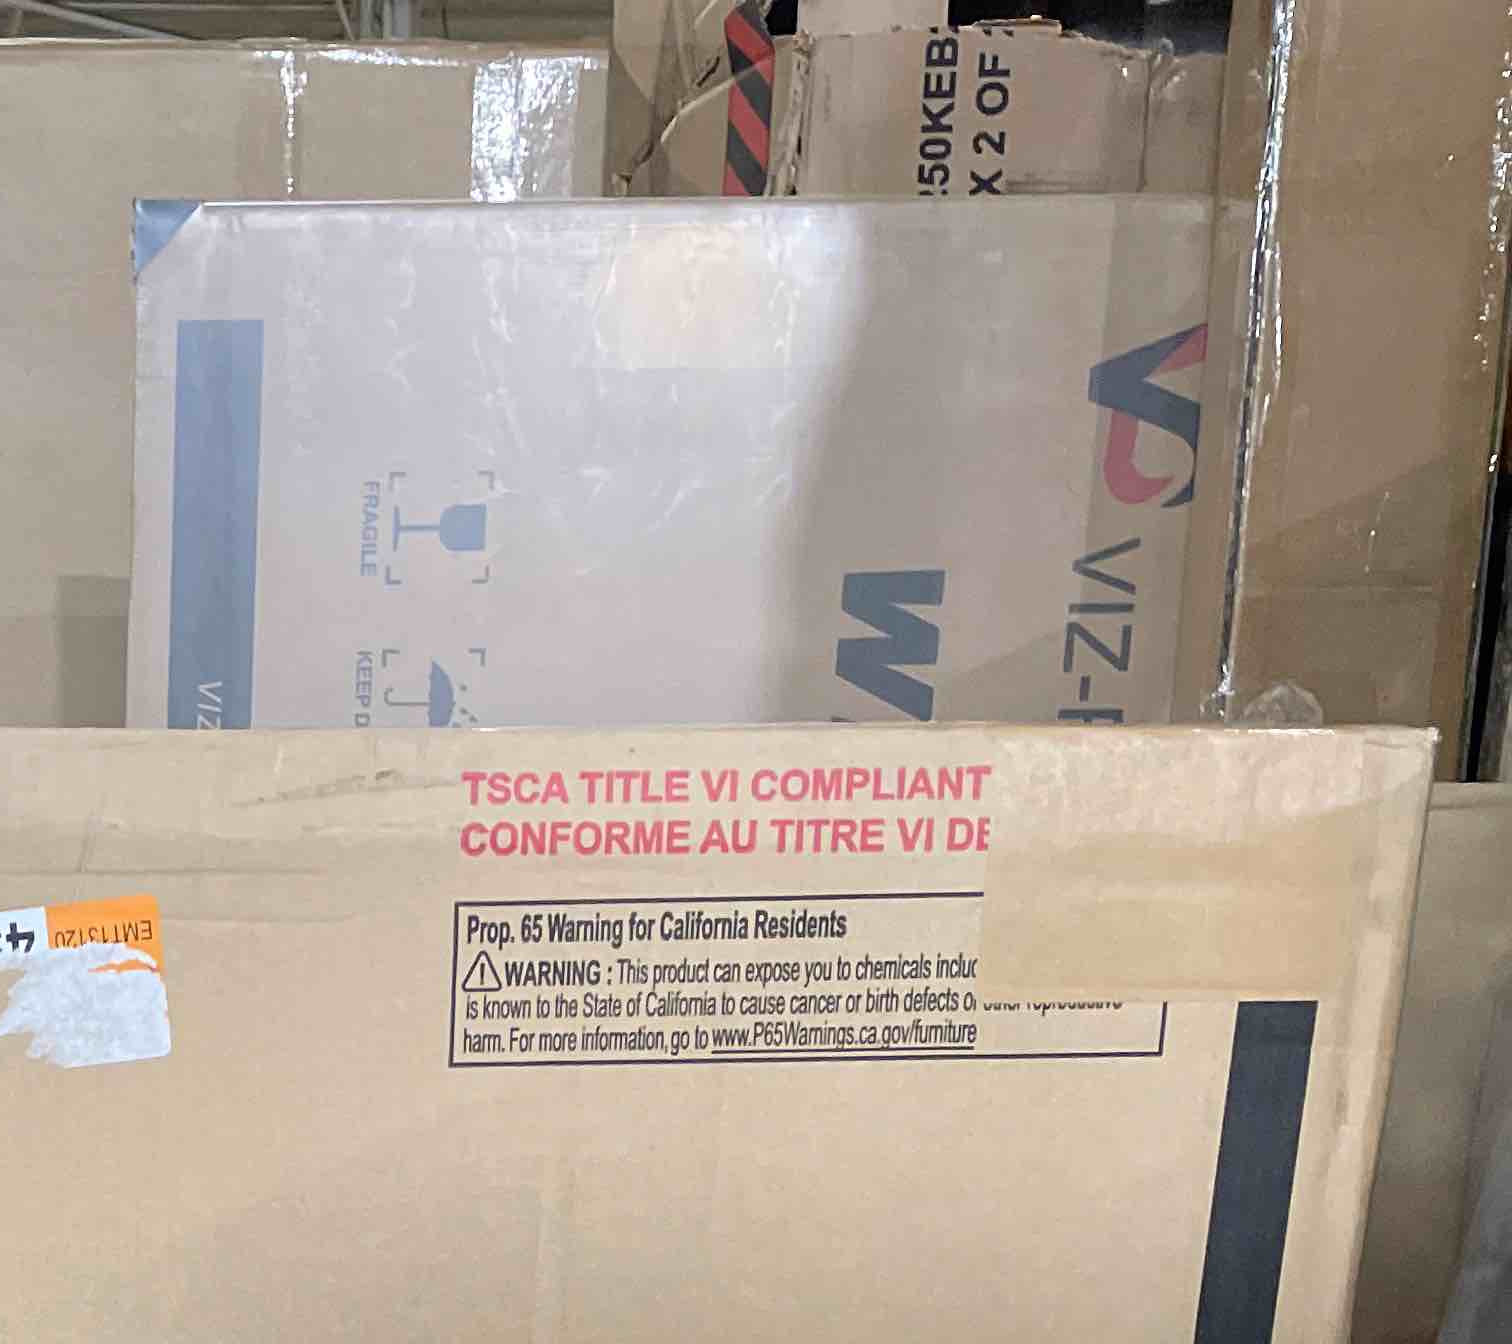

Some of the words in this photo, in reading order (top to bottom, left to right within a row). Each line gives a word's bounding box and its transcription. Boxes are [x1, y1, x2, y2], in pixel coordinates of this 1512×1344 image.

[977, 53, 1011, 117] OF
[918, 25, 959, 196] 50KEB
[360, 481, 381, 577] FRAGILE
[355, 651, 373, 708] KEEP
[460, 771, 569, 806] TSCA
[579, 769, 692, 804] TITLE
[700, 768, 739, 802] VI
[750, 765, 992, 802] COMPLIANT
[459, 820, 696, 857] CONFORME
[698, 819, 758, 855] AU
[769, 818, 884, 854] TITRE
[896, 817, 935, 853] VI
[466, 914, 516, 951] Prop.
[521, 914, 543, 942] 65
[547, 912, 623, 949] Warning
[628, 912, 656, 942] for
[660, 910, 748, 941] California
[753, 908, 848, 940] Residents
[504, 959, 601, 987] WARNING
[617, 958, 649, 985] This
[652, 957, 712, 991] product
[713, 962, 741, 984] can
[744, 960, 800, 988] expose
[804, 962, 832, 988] you
[836, 956, 851, 981] to
[855, 953, 932, 980] chemicals
[465, 994, 480, 1020] is
[483, 992, 532, 1019] known
[536, 993, 551, 1018] to
[554, 992, 578, 1018] the
[582, 992, 622, 1017] State
[626, 991, 644, 1017] of
[645, 989, 717, 1017] California
[721, 991, 735, 1016] to
[739, 993, 786, 1015] cause
[790, 991, 842, 1014] cancer
[846, 991, 860, 1013] or
[865, 987, 900, 1014] birth
[904, 986, 960, 1013] defects
[463, 1028, 506, 1054] harm.
[509, 1027, 536, 1052] For
[538, 1031, 577, 1052] more
[694, 1024, 709, 1050] to
